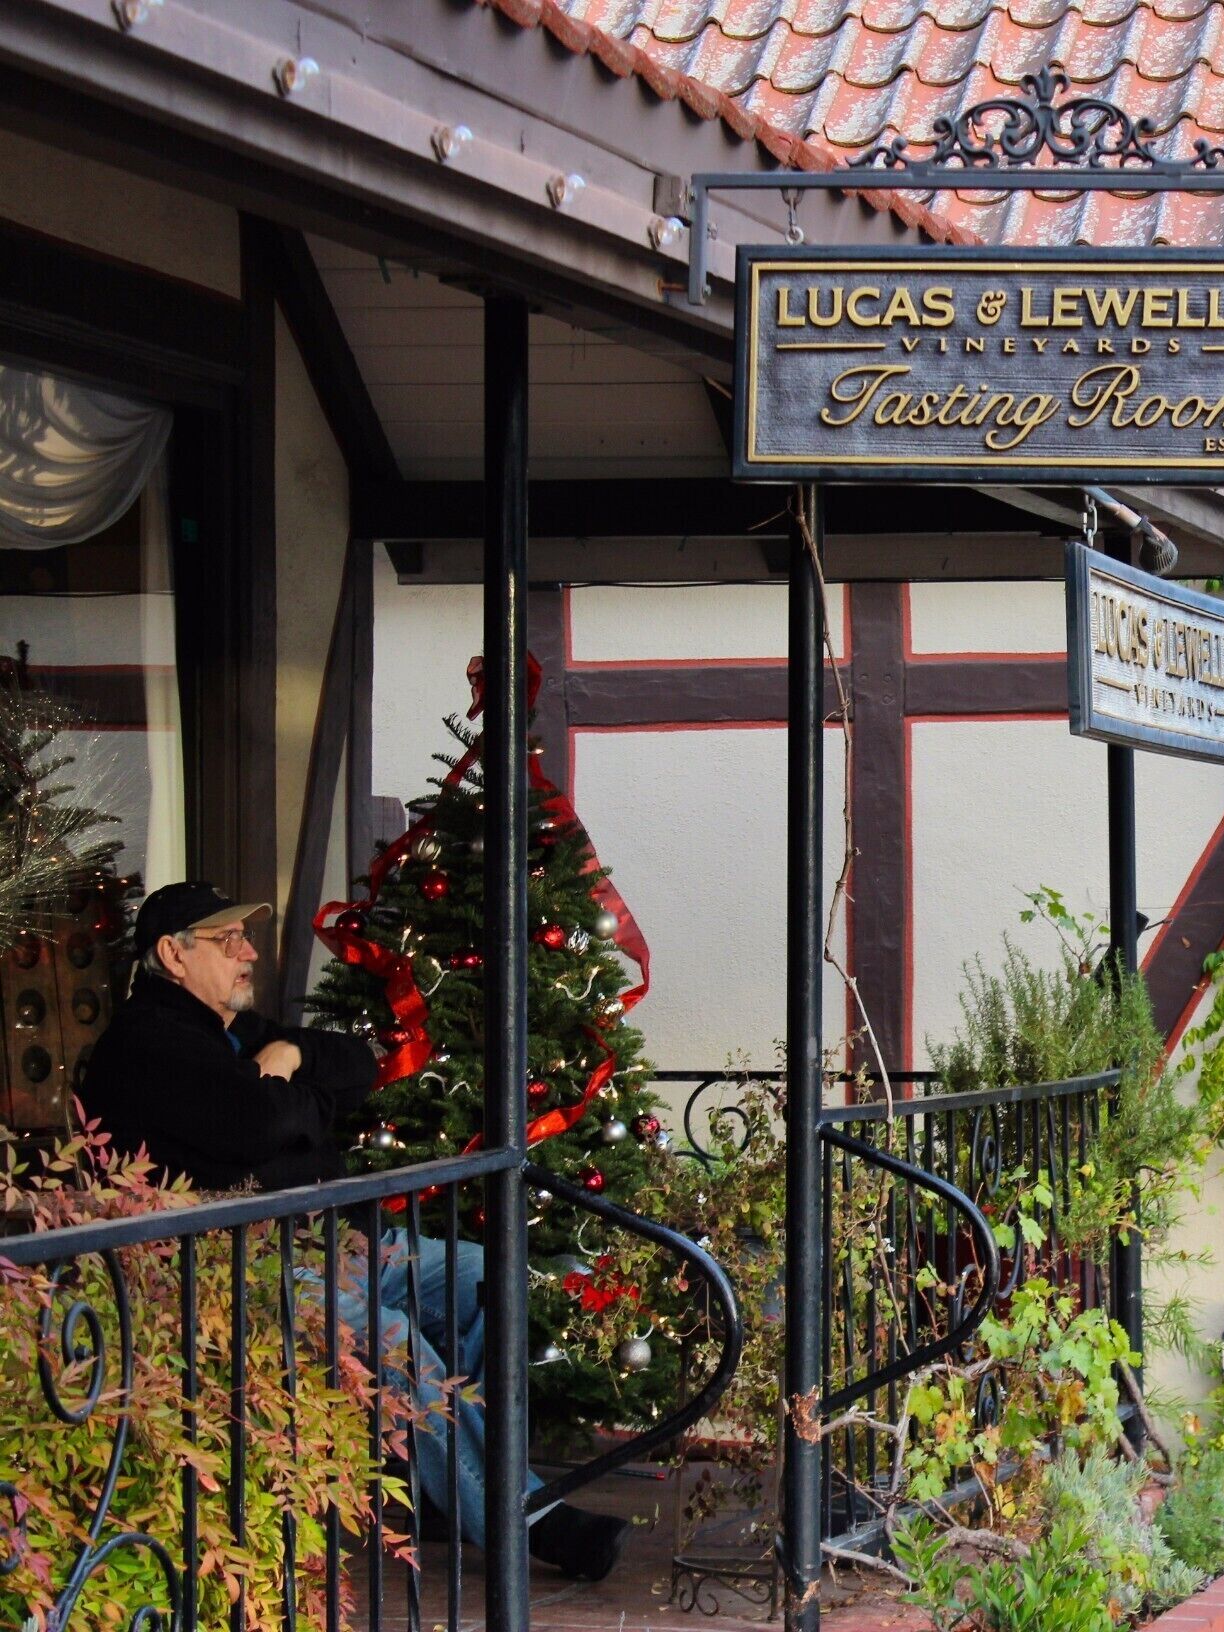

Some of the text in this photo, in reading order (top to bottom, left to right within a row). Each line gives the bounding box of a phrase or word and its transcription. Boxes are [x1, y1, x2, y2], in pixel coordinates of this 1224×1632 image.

[776, 287, 955, 327] LUCAS
[976, 289, 1006, 327] &
[903, 337, 1183, 355] VINEYARDS
[820, 364, 1060, 451] Tasting
